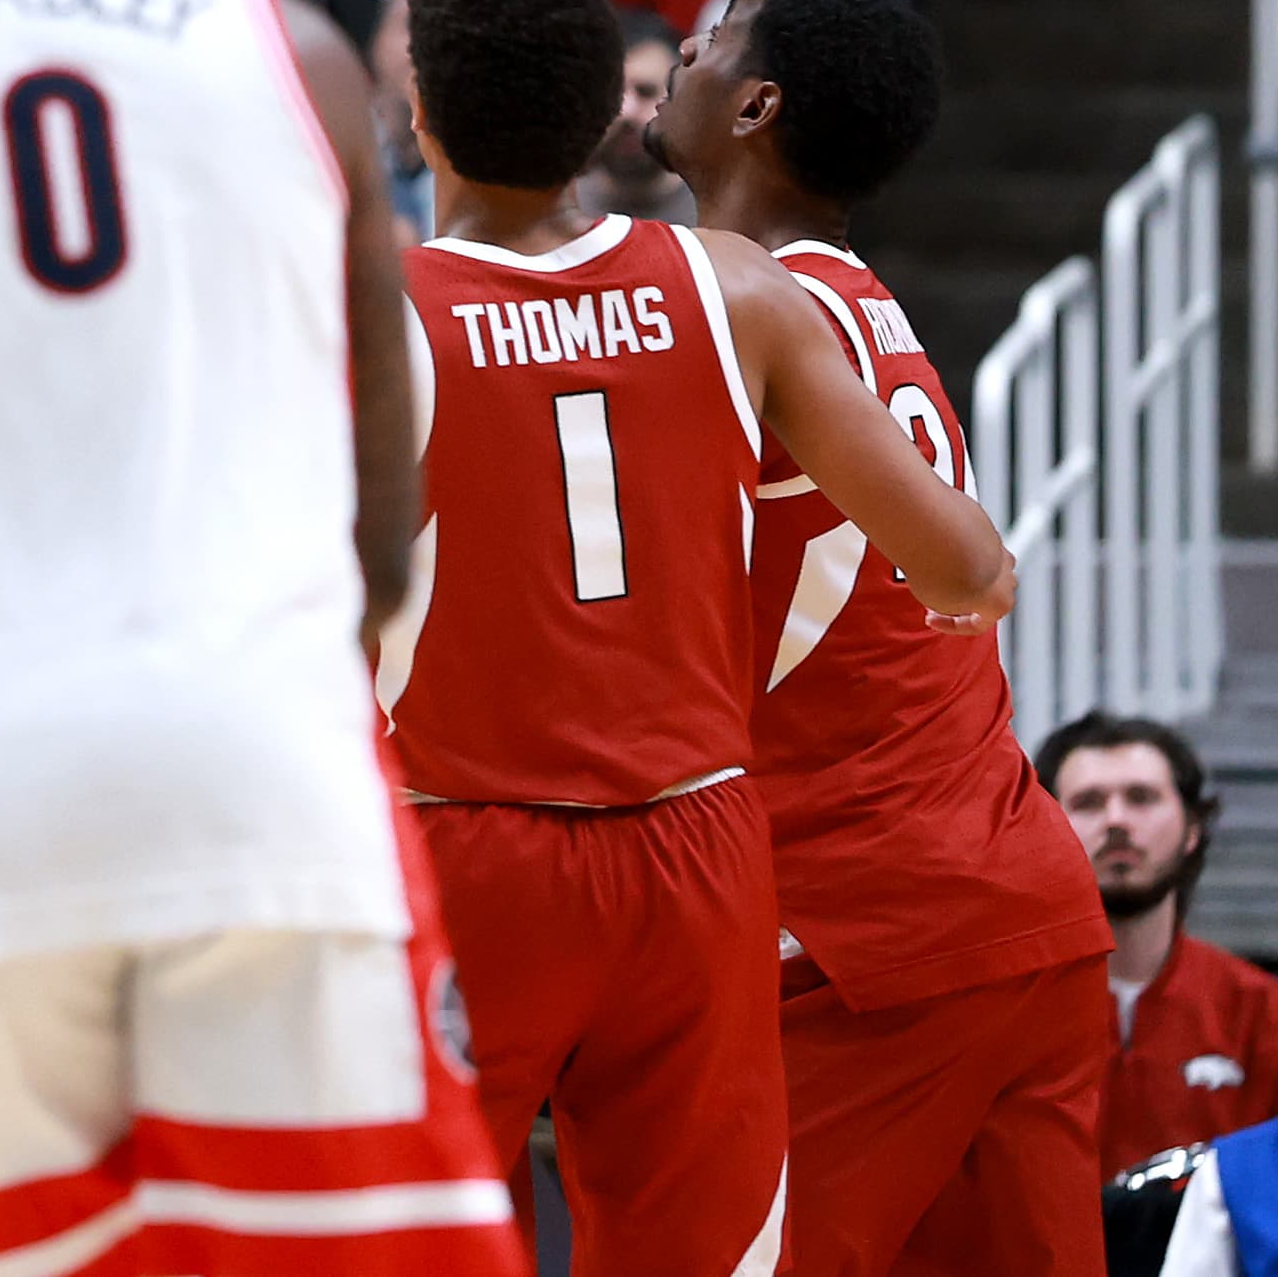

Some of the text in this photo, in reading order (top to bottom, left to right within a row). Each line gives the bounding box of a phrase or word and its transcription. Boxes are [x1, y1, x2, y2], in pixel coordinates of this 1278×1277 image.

[1, 63, 129, 295] 0
[452, 286, 674, 368] THOMAS
[553, 390, 627, 602] 1
